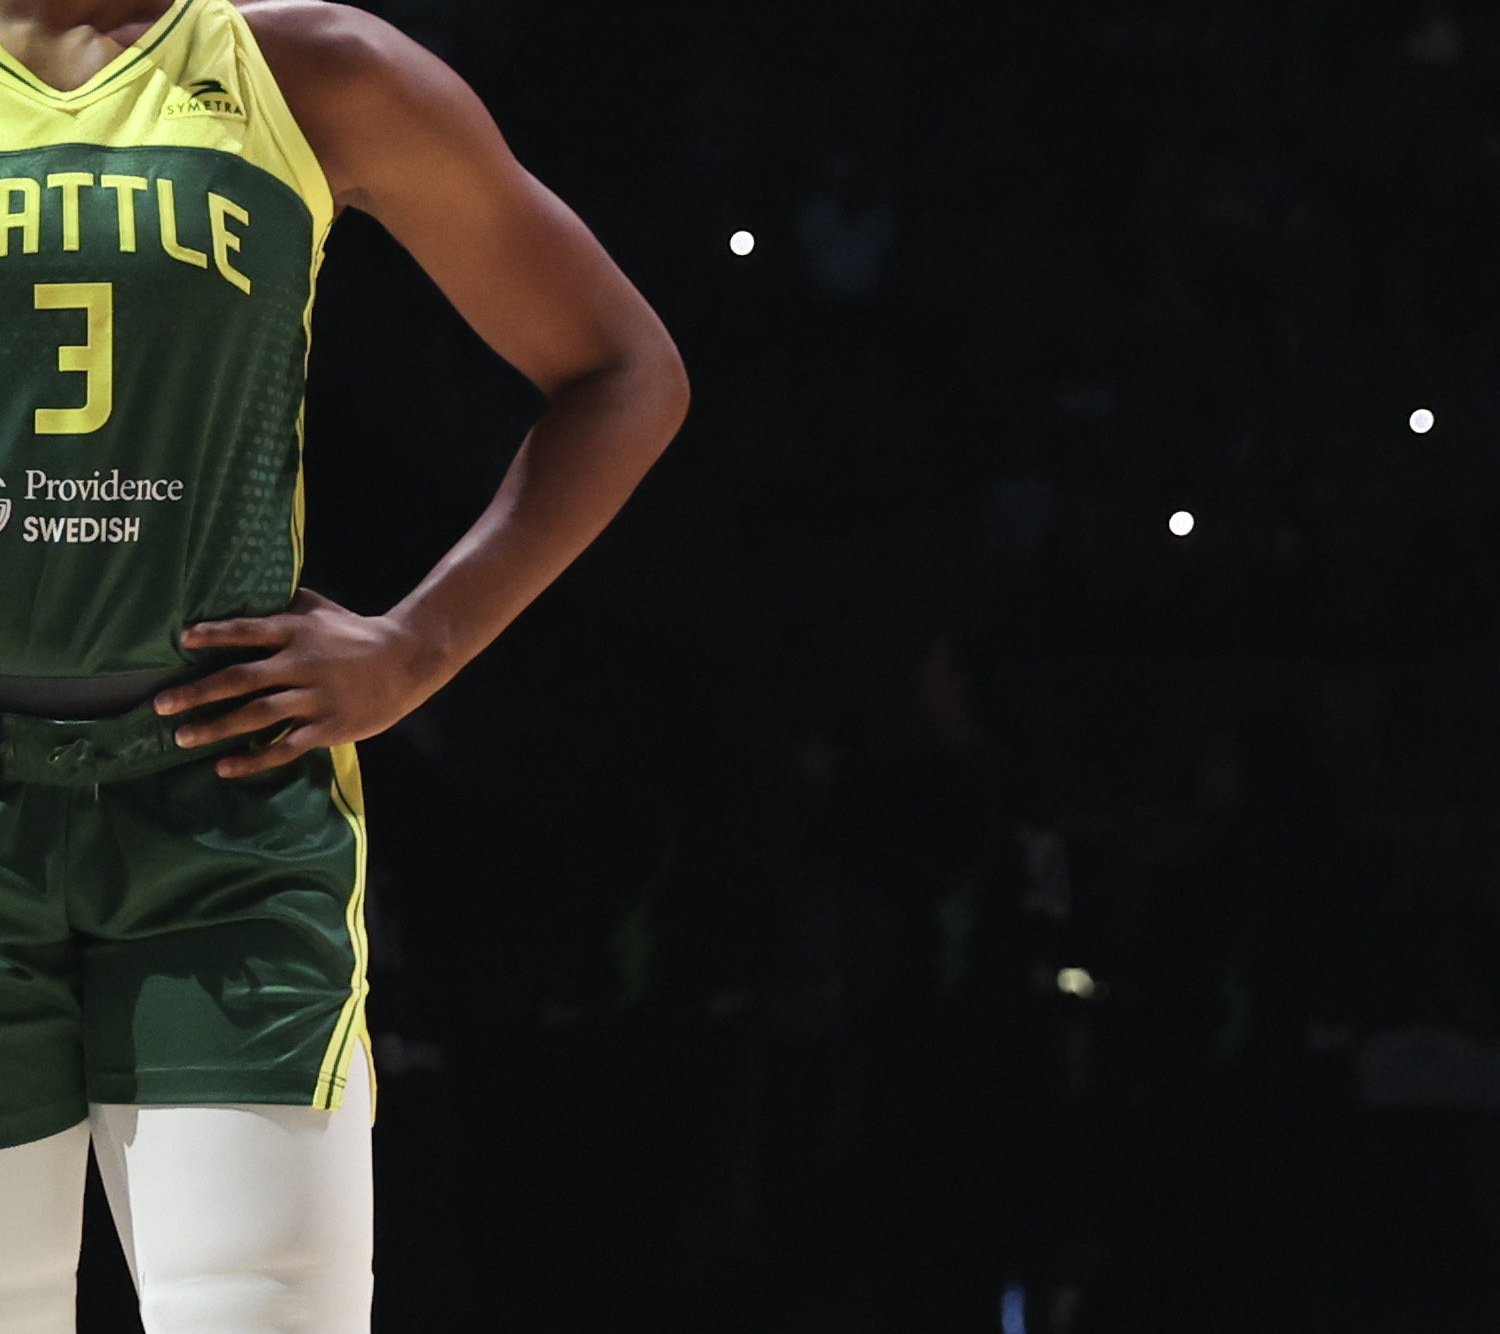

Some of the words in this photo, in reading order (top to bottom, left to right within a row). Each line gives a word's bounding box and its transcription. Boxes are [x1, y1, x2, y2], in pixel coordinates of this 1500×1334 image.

[167, 101, 244, 117] SYMETRA
[34, 282, 113, 435] 3
[23, 469, 184, 502] Providence
[22, 516, 141, 544] SWEDISH
